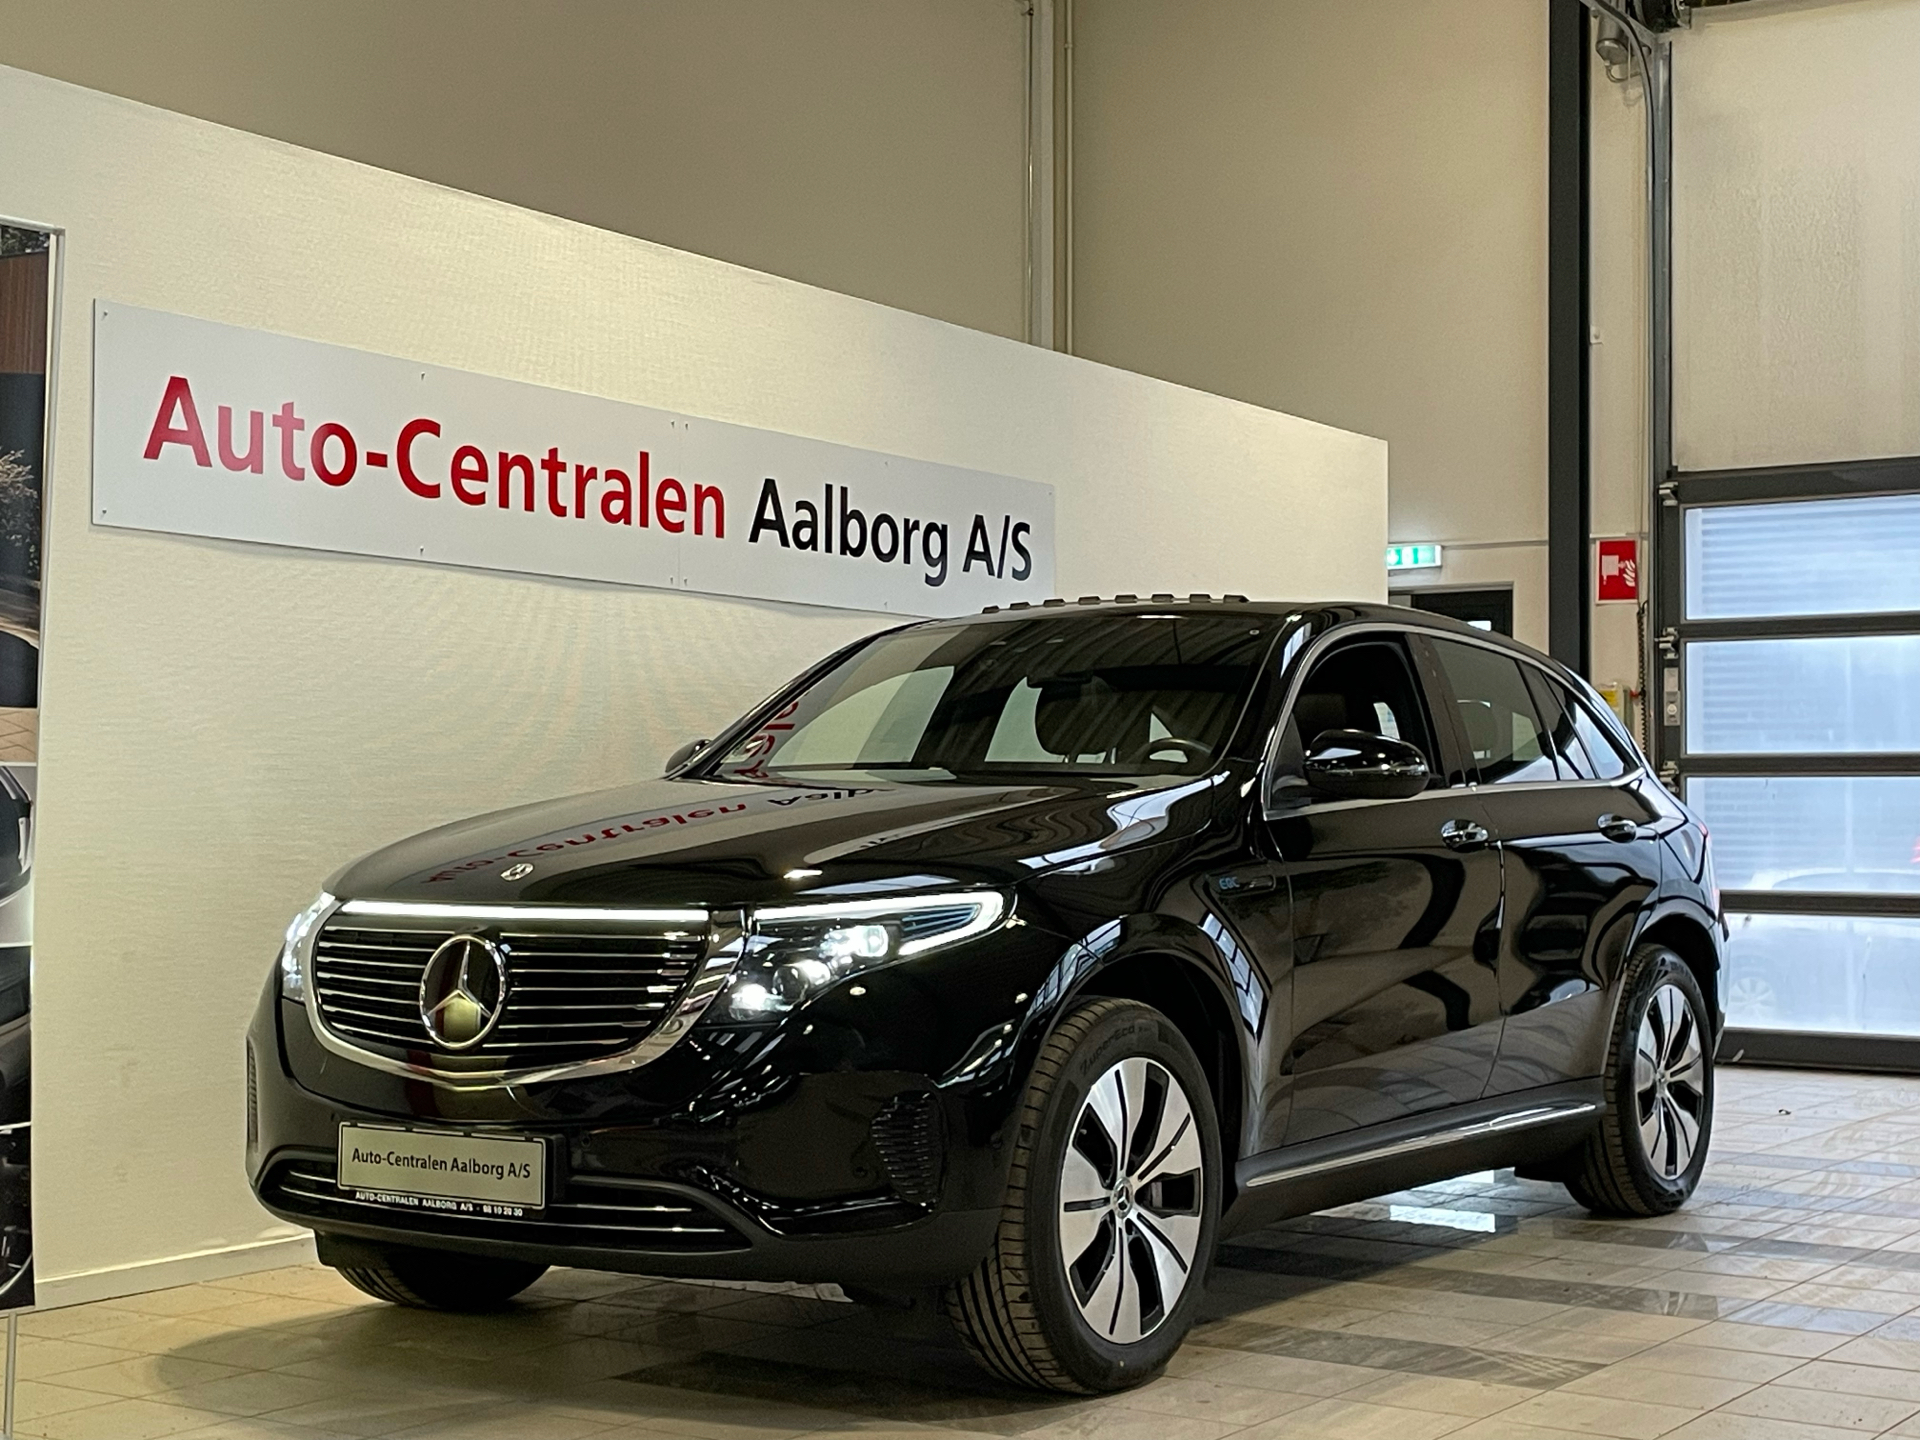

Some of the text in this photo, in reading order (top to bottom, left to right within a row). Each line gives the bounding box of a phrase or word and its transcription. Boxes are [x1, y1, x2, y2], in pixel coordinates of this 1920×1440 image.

[143, 375, 1032, 587] Auto-Centralen Aalborg A/S
[352, 1147, 531, 1181] Auto-Centralen Aalborg A/S
[355, 1191, 419, 1206] AUTO-CENTRALEN
[422, 1198, 457, 1211] AALBORG
[460, 1202, 474, 1212] A/S
